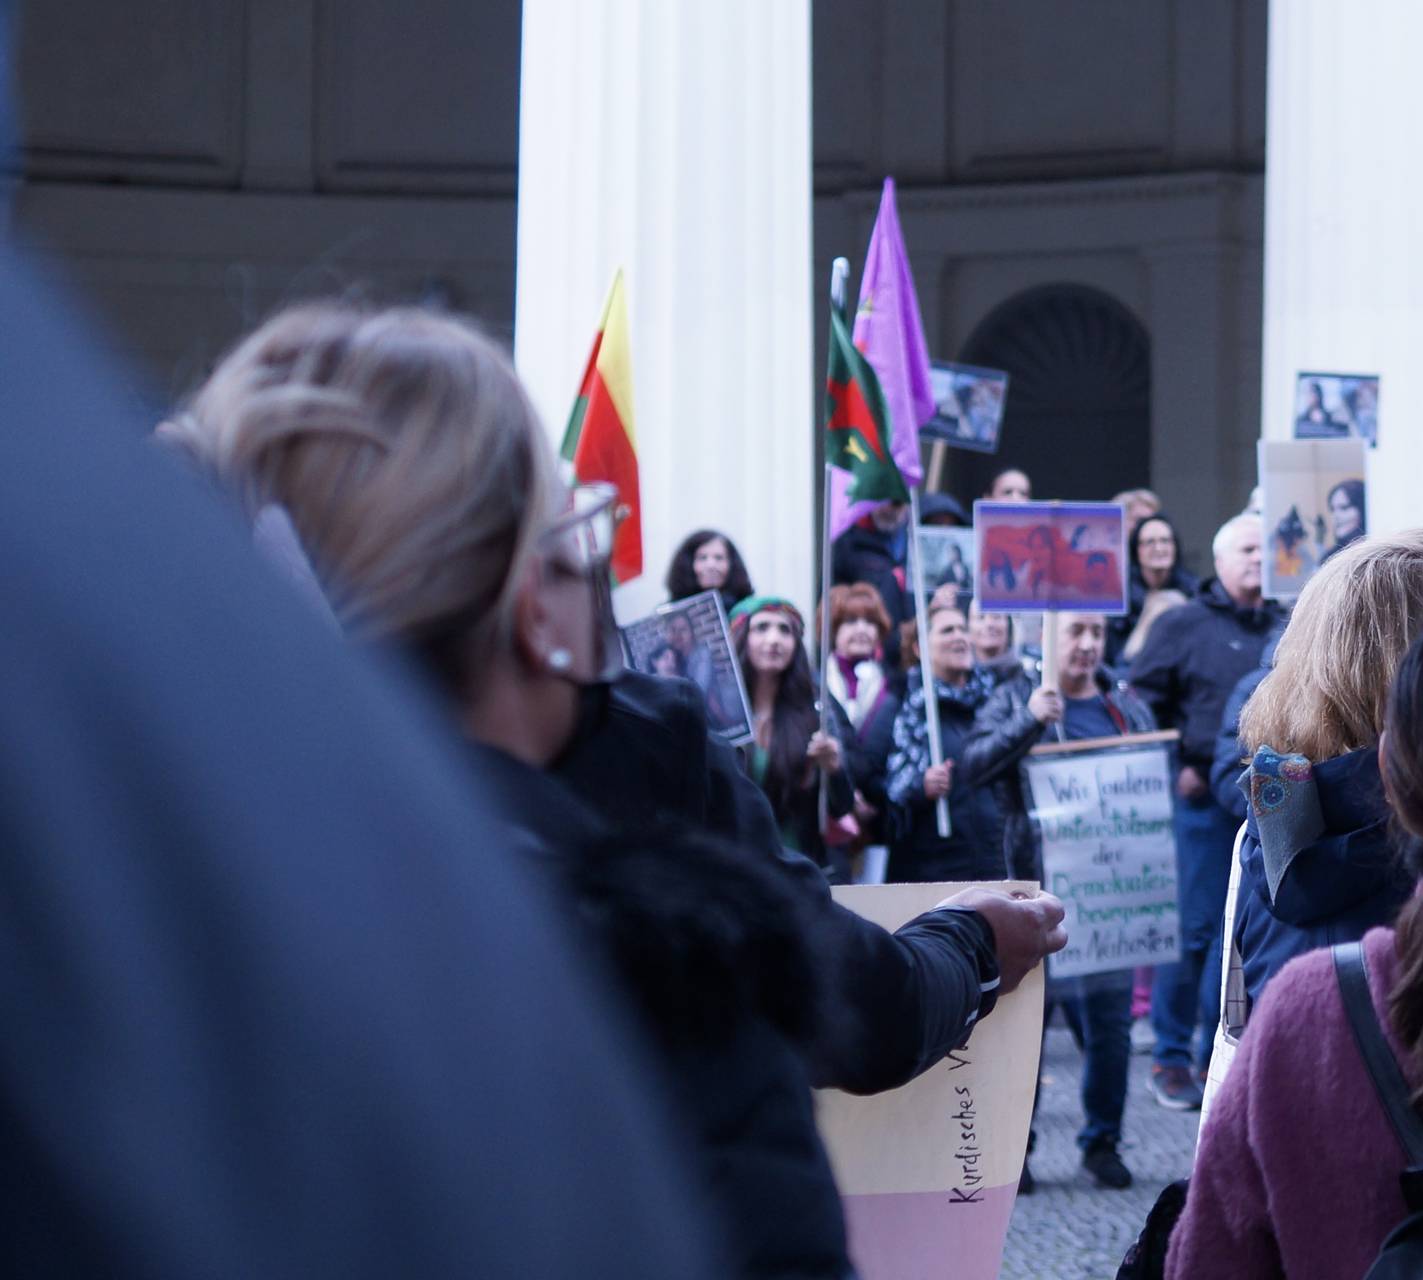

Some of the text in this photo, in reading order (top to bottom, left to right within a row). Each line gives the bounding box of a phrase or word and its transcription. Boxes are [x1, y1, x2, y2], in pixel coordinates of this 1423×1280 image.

[1048, 774, 1089, 803] Wir
[1092, 842, 1123, 865] der
[948, 1086, 985, 1204] Kurdisches
